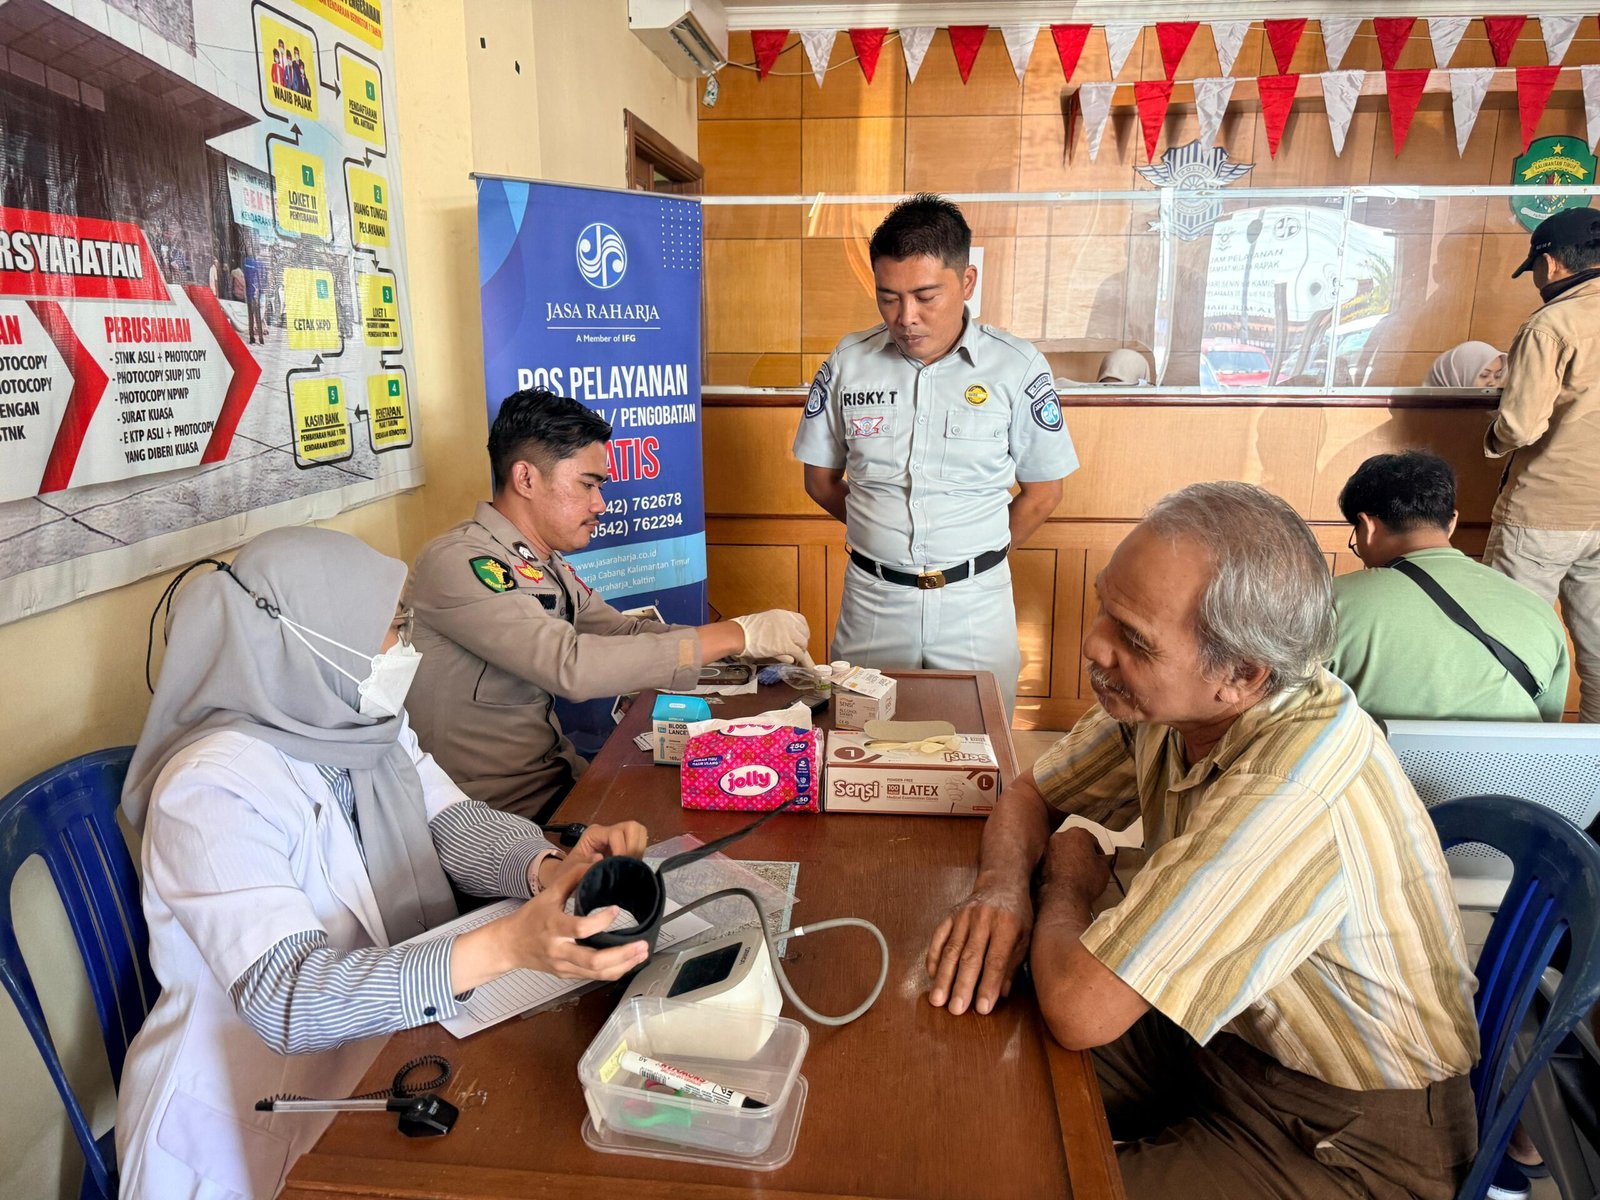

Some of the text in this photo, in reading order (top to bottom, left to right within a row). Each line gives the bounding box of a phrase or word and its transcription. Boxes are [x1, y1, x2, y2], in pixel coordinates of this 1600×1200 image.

[272, 86, 312, 112] WAJIB PAJAK
[349, 98, 378, 120] PENDAFTARAN
[1534, 160, 1577, 170] KALIMANTAN TIMUR
[305, 171, 310, 182] 7
[288, 190, 312, 207] LOKET
[312, 196, 317, 210] II
[354, 202, 388, 222] RUANG TUNGGU
[359, 222, 386, 238] PELAYANAN
[1254, 260, 1280, 270] RAPAK
[546, 302, 660, 322] JASA RAHARJA
[104, 316, 192, 344] PERUSAHAAN
[294, 319, 332, 331] CETAK SKPD
[576, 334, 582, 342] A
[583, 334, 611, 342] Member
[622, 334, 636, 342] IFG
[114, 351, 136, 365] STNK
[138, 350, 155, 364] ASLI
[164, 350, 206, 363] PHOTOCOPY
[116, 368, 200, 384] PHOTOCOPY SIUP/ SITU
[518, 364, 688, 400] POS PELAYANAN
[0, 377, 52, 394] OTOCOPY
[392, 384, 396, 392] 4
[120, 388, 189, 404] PHOTOCOPY NPWP
[331, 390, 336, 400] 5
[844, 391, 898, 406] RISKY. T
[122, 407, 174, 424] SURAT KUASA
[304, 412, 340, 428] KASIR BANK
[376, 406, 402, 420] PENETAPAN
[620, 403, 696, 428] PENGOBATAN
[124, 432, 129, 444] E
[130, 430, 145, 444] KTP
[146, 427, 164, 441] ASLI
[174, 420, 214, 437] PHOTOCOPY
[300, 431, 326, 442] PEMBAYARAN
[125, 442, 199, 464] YANG DIBERI KUASA
[304, 441, 328, 452] KENDARAAN
[605, 436, 660, 483] ATIS
[632, 492, 682, 511] 762678
[633, 512, 683, 532] 762294
[575, 550, 656, 571] www.jasaraharja.co.id
[598, 568, 626, 580] Cabang
[627, 562, 669, 574] Kalimantan
[670, 558, 690, 567] Timur
[845, 750, 855, 758] L
[944, 752, 990, 762] Sensi
[728, 770, 770, 792] jolly
[982, 778, 988, 788] L
[834, 779, 880, 802] Sensi
[902, 785, 938, 796] LATEX
